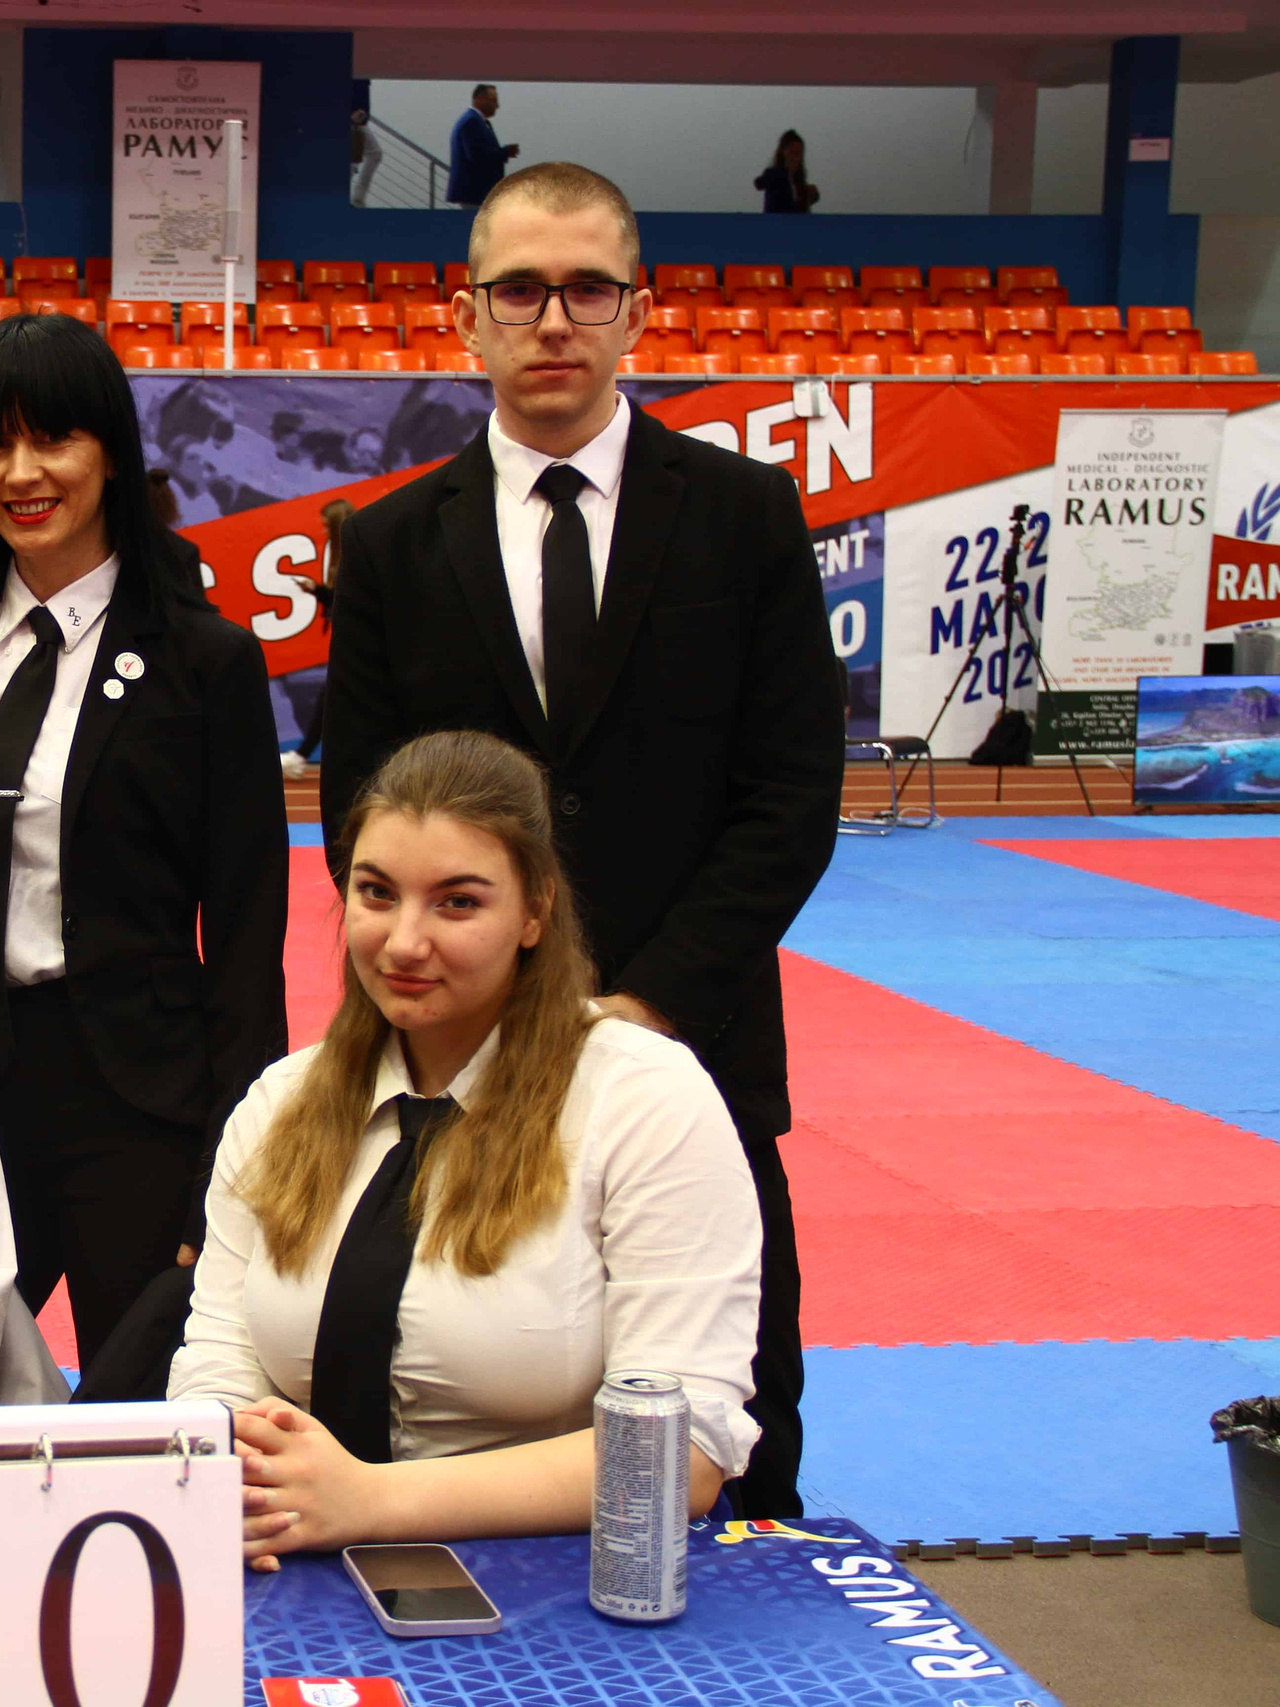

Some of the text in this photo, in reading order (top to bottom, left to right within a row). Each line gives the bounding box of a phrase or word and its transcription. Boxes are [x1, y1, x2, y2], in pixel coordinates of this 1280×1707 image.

[1097, 452, 1181, 461] INDEPENDENT
[1067, 464, 1118, 474] MEDICAL
[1134, 463, 1210, 474] DIAGNOSTIC
[1067, 477, 1208, 492] LABORATORY
[1063, 496, 1206, 527] RAMUS
[810, 1555, 1006, 1679] RAMUS
